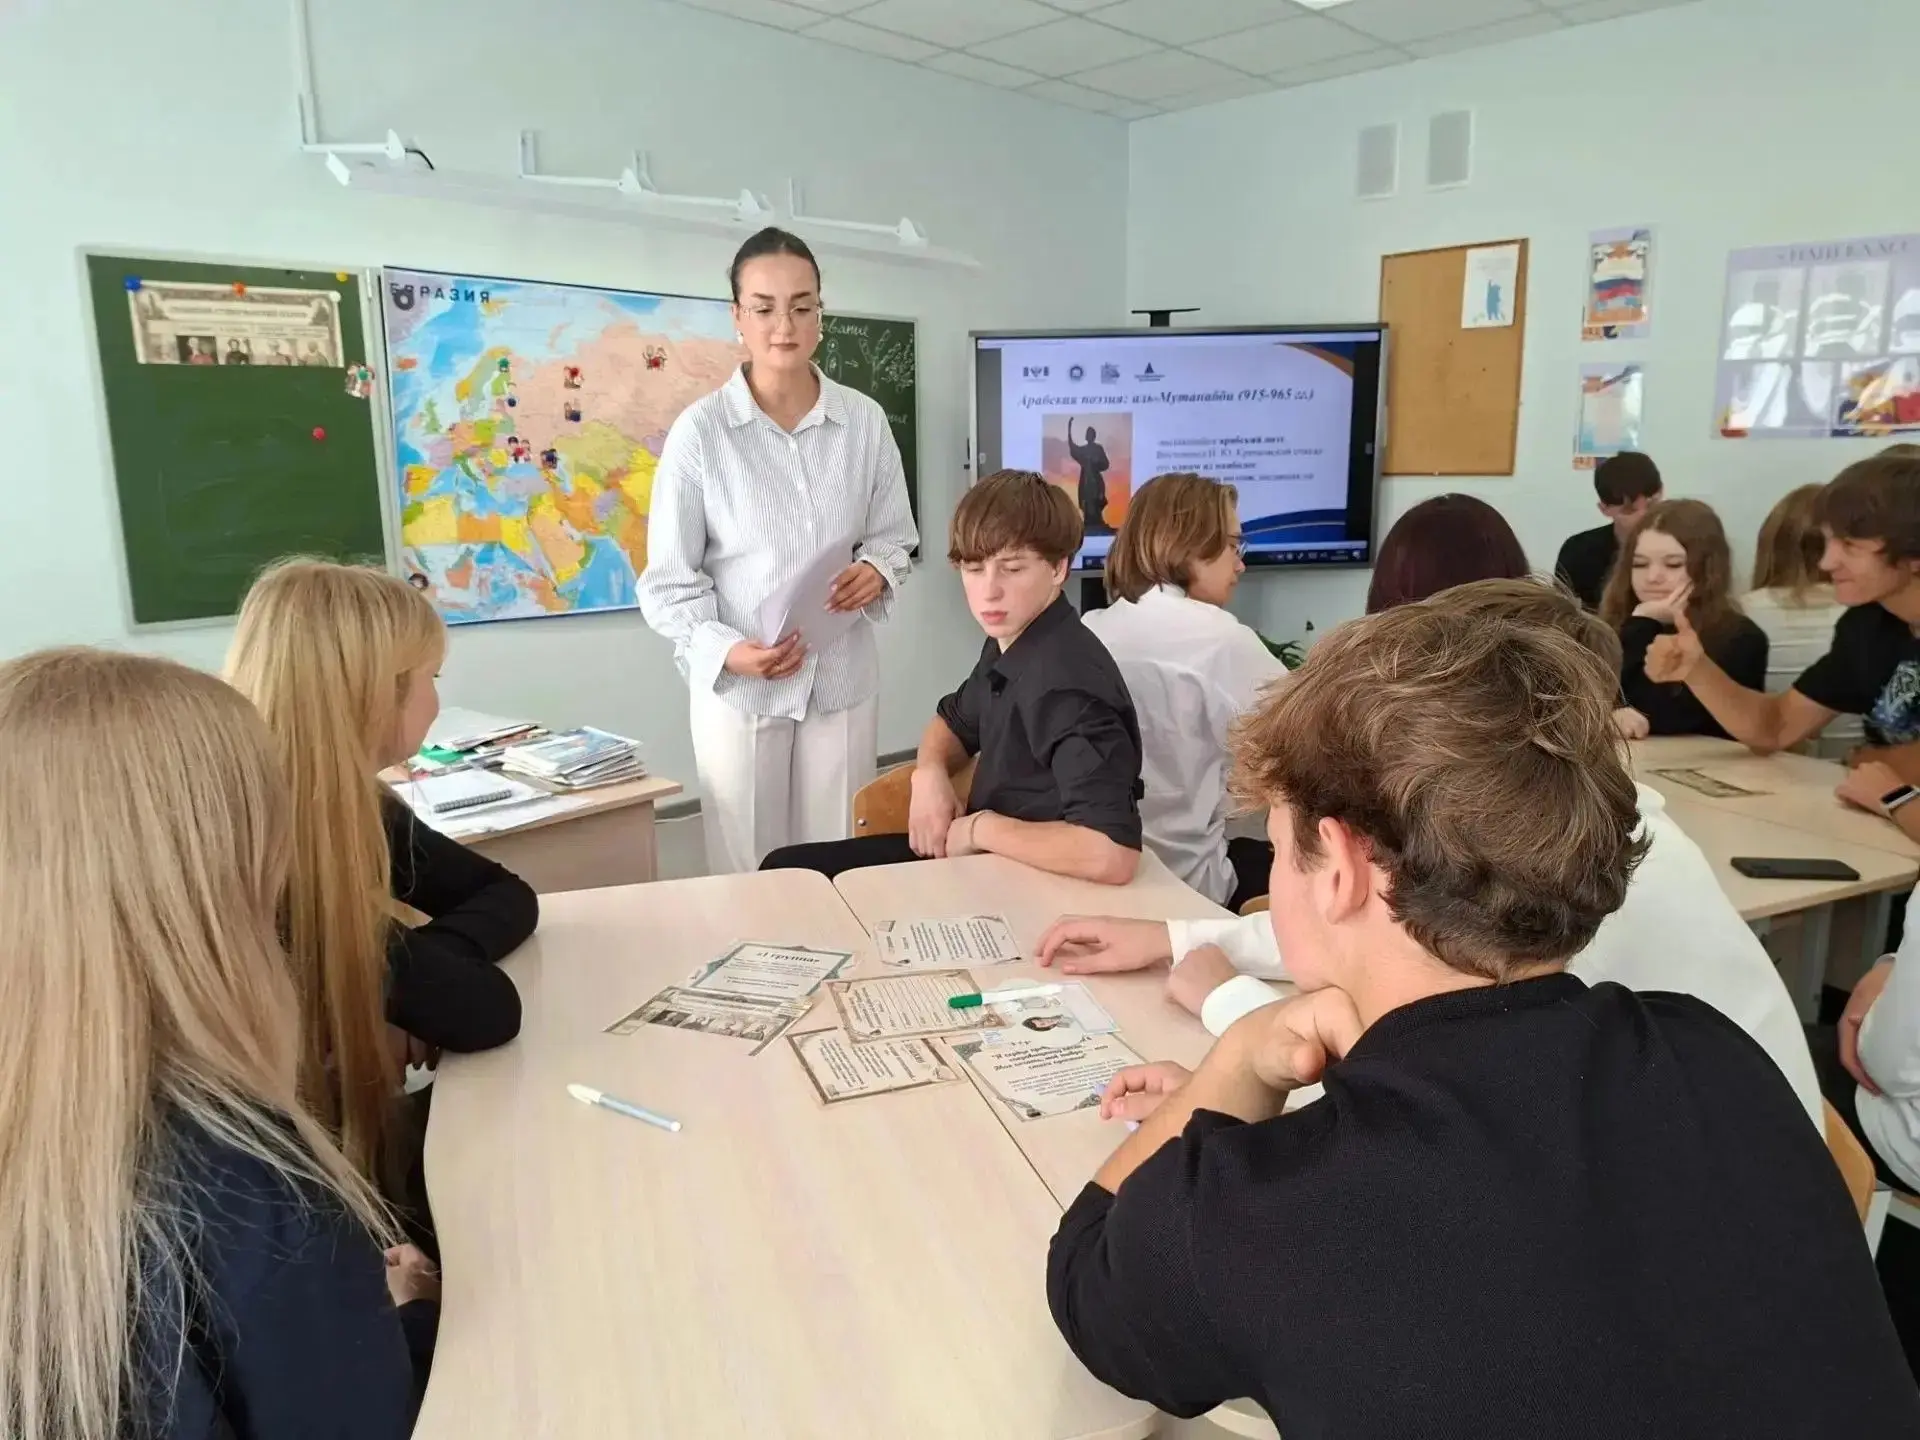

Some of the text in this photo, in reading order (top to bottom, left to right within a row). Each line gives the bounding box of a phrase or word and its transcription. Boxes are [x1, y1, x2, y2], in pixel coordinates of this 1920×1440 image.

[390, 282, 490, 303] ЕВРАЗИЯ
[1018, 394, 1077, 408] Арабская
[1082, 395, 1128, 405] поэзия:
[1238, 388, 1292, 402] (915-965
